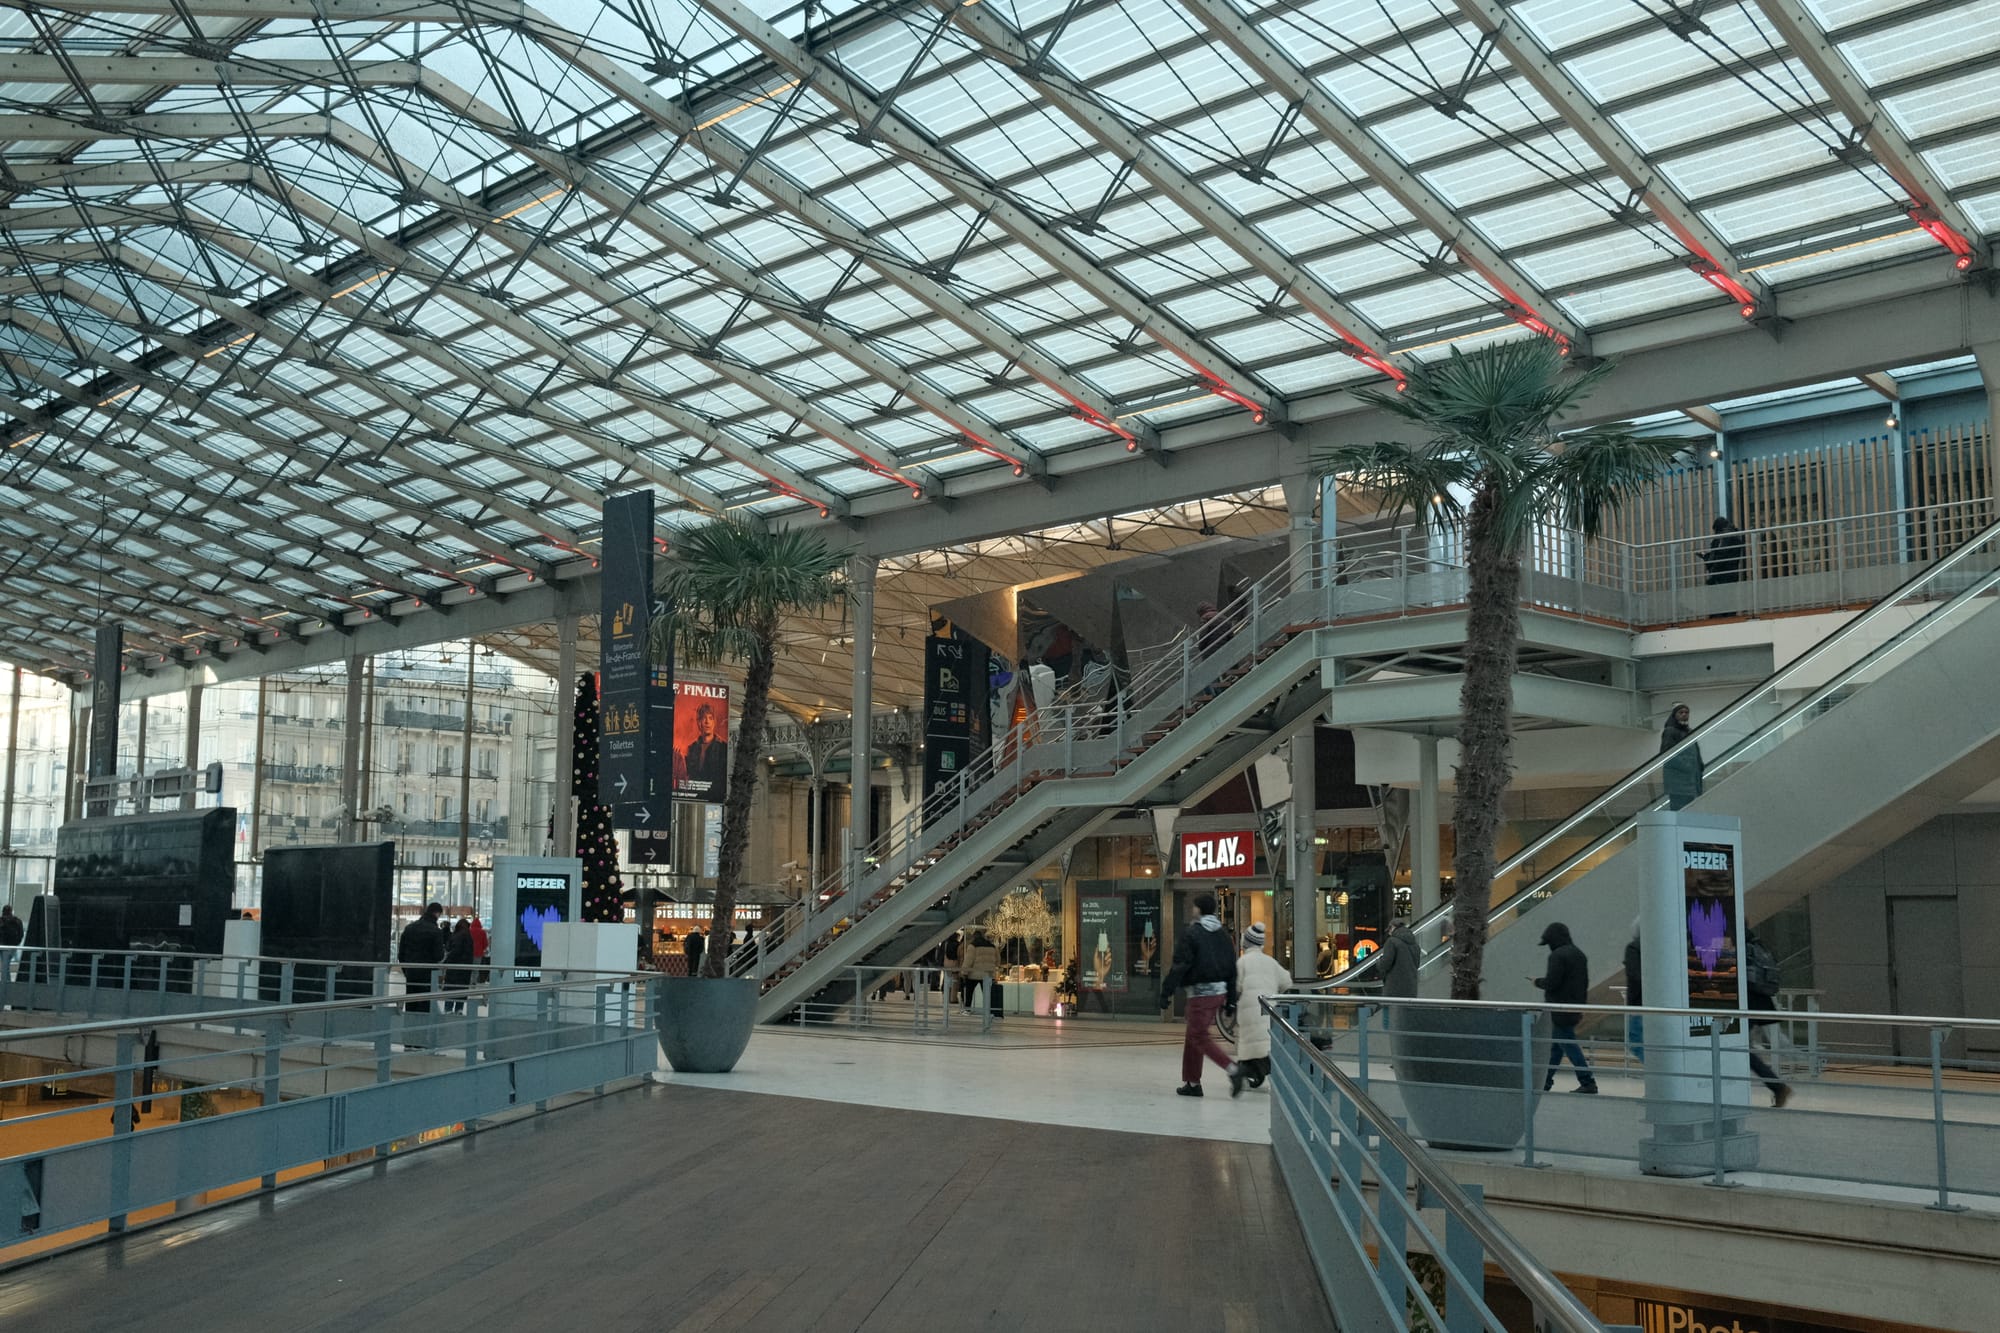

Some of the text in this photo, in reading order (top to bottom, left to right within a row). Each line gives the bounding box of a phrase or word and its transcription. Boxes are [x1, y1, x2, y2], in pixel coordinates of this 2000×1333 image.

[684, 684, 727, 699] FINALE
[609, 740, 634, 750] Toilettes
[1682, 850, 1728, 871] DEEZER
[517, 878, 566, 890] DEEZER
[656, 909, 693, 919] PIERRE
[735, 910, 762, 919] PARIS
